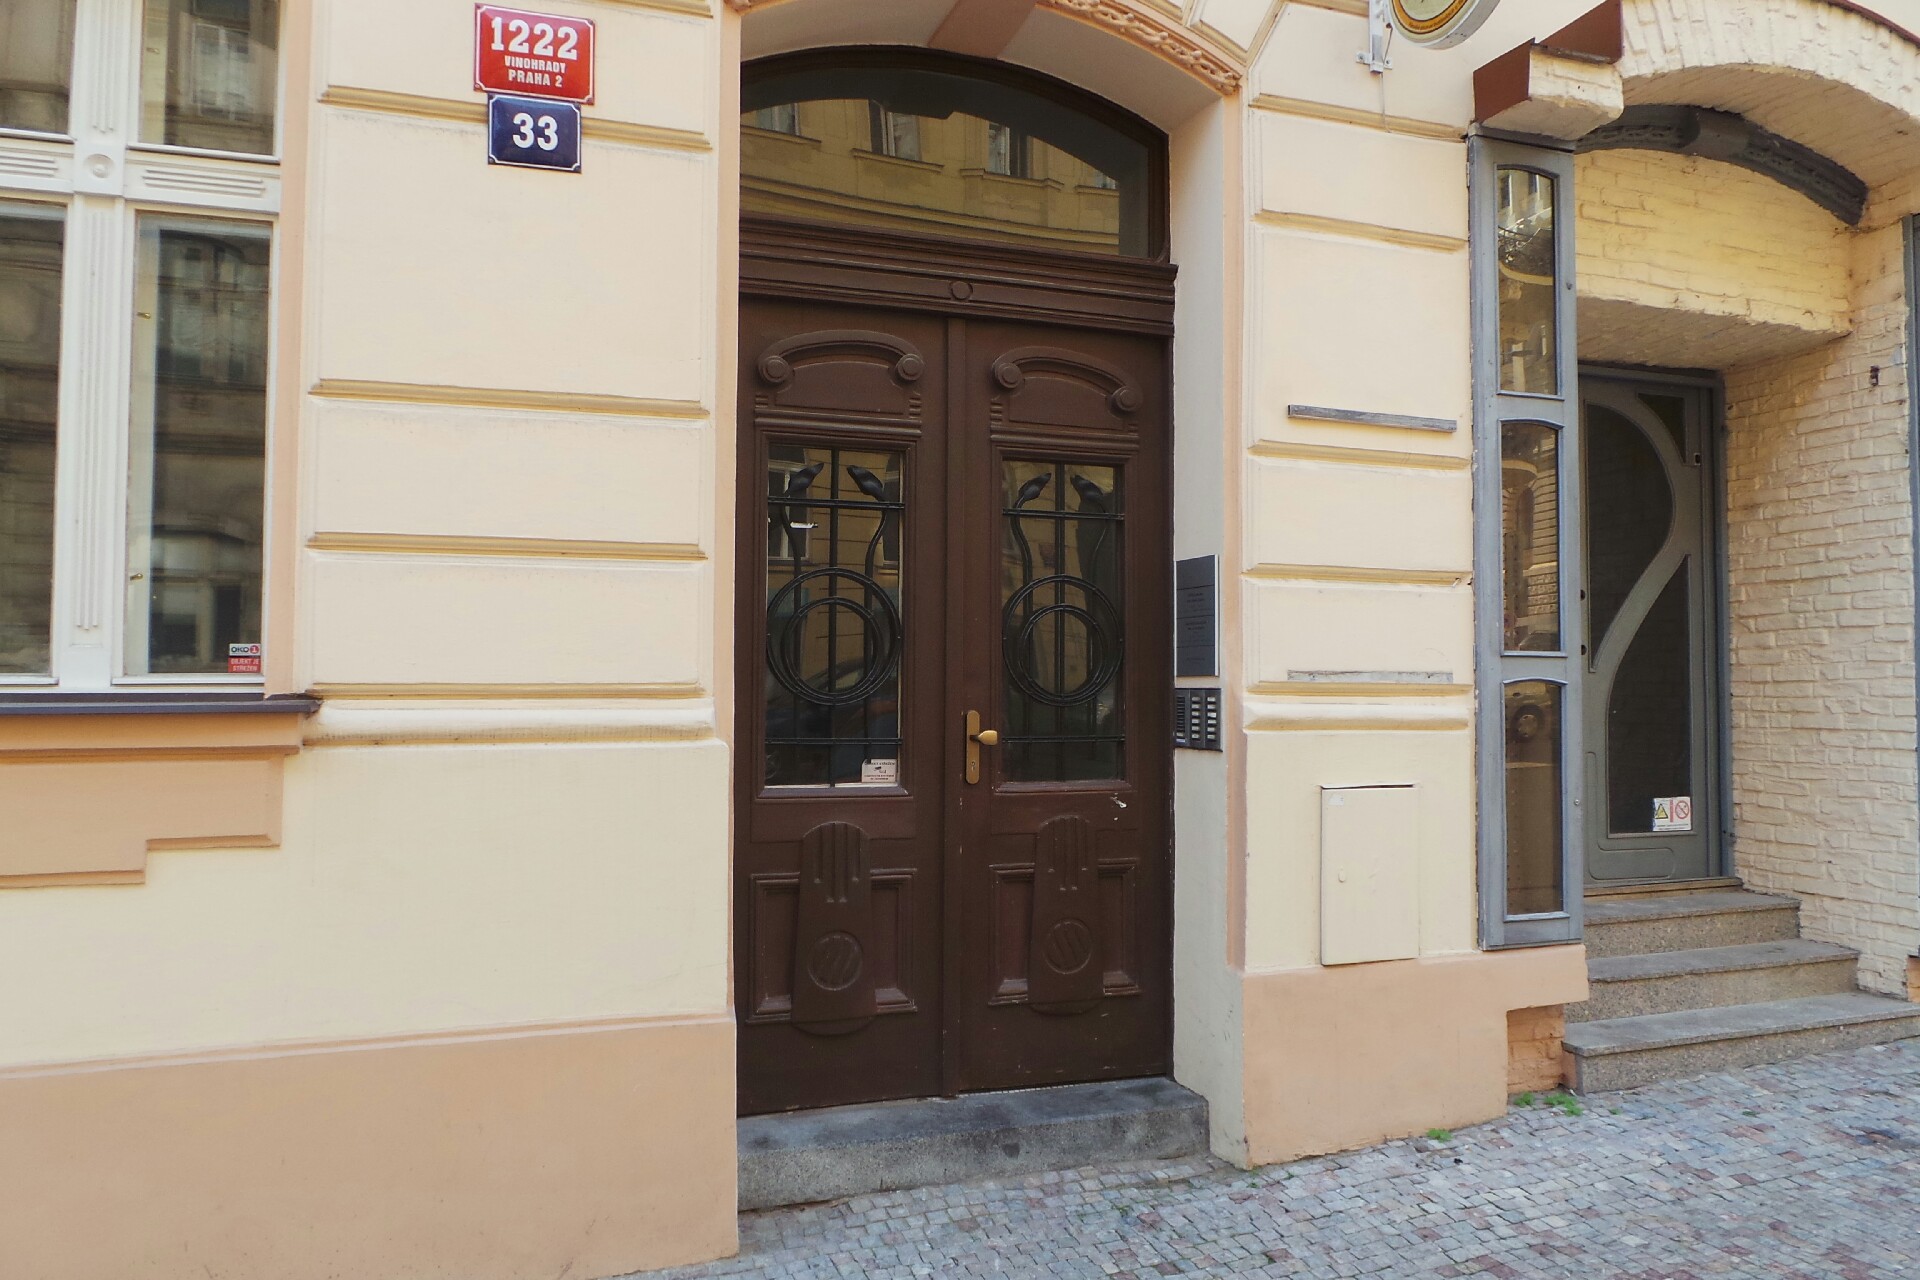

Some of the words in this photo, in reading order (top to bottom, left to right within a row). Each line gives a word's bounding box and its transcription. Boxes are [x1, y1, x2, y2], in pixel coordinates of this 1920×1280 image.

[491, 16, 578, 60] 1222
[504, 55, 566, 73] VINOHRADY
[508, 70, 551, 86] PRAHA
[555, 75, 563, 88] 2
[512, 112, 559, 151] 33
